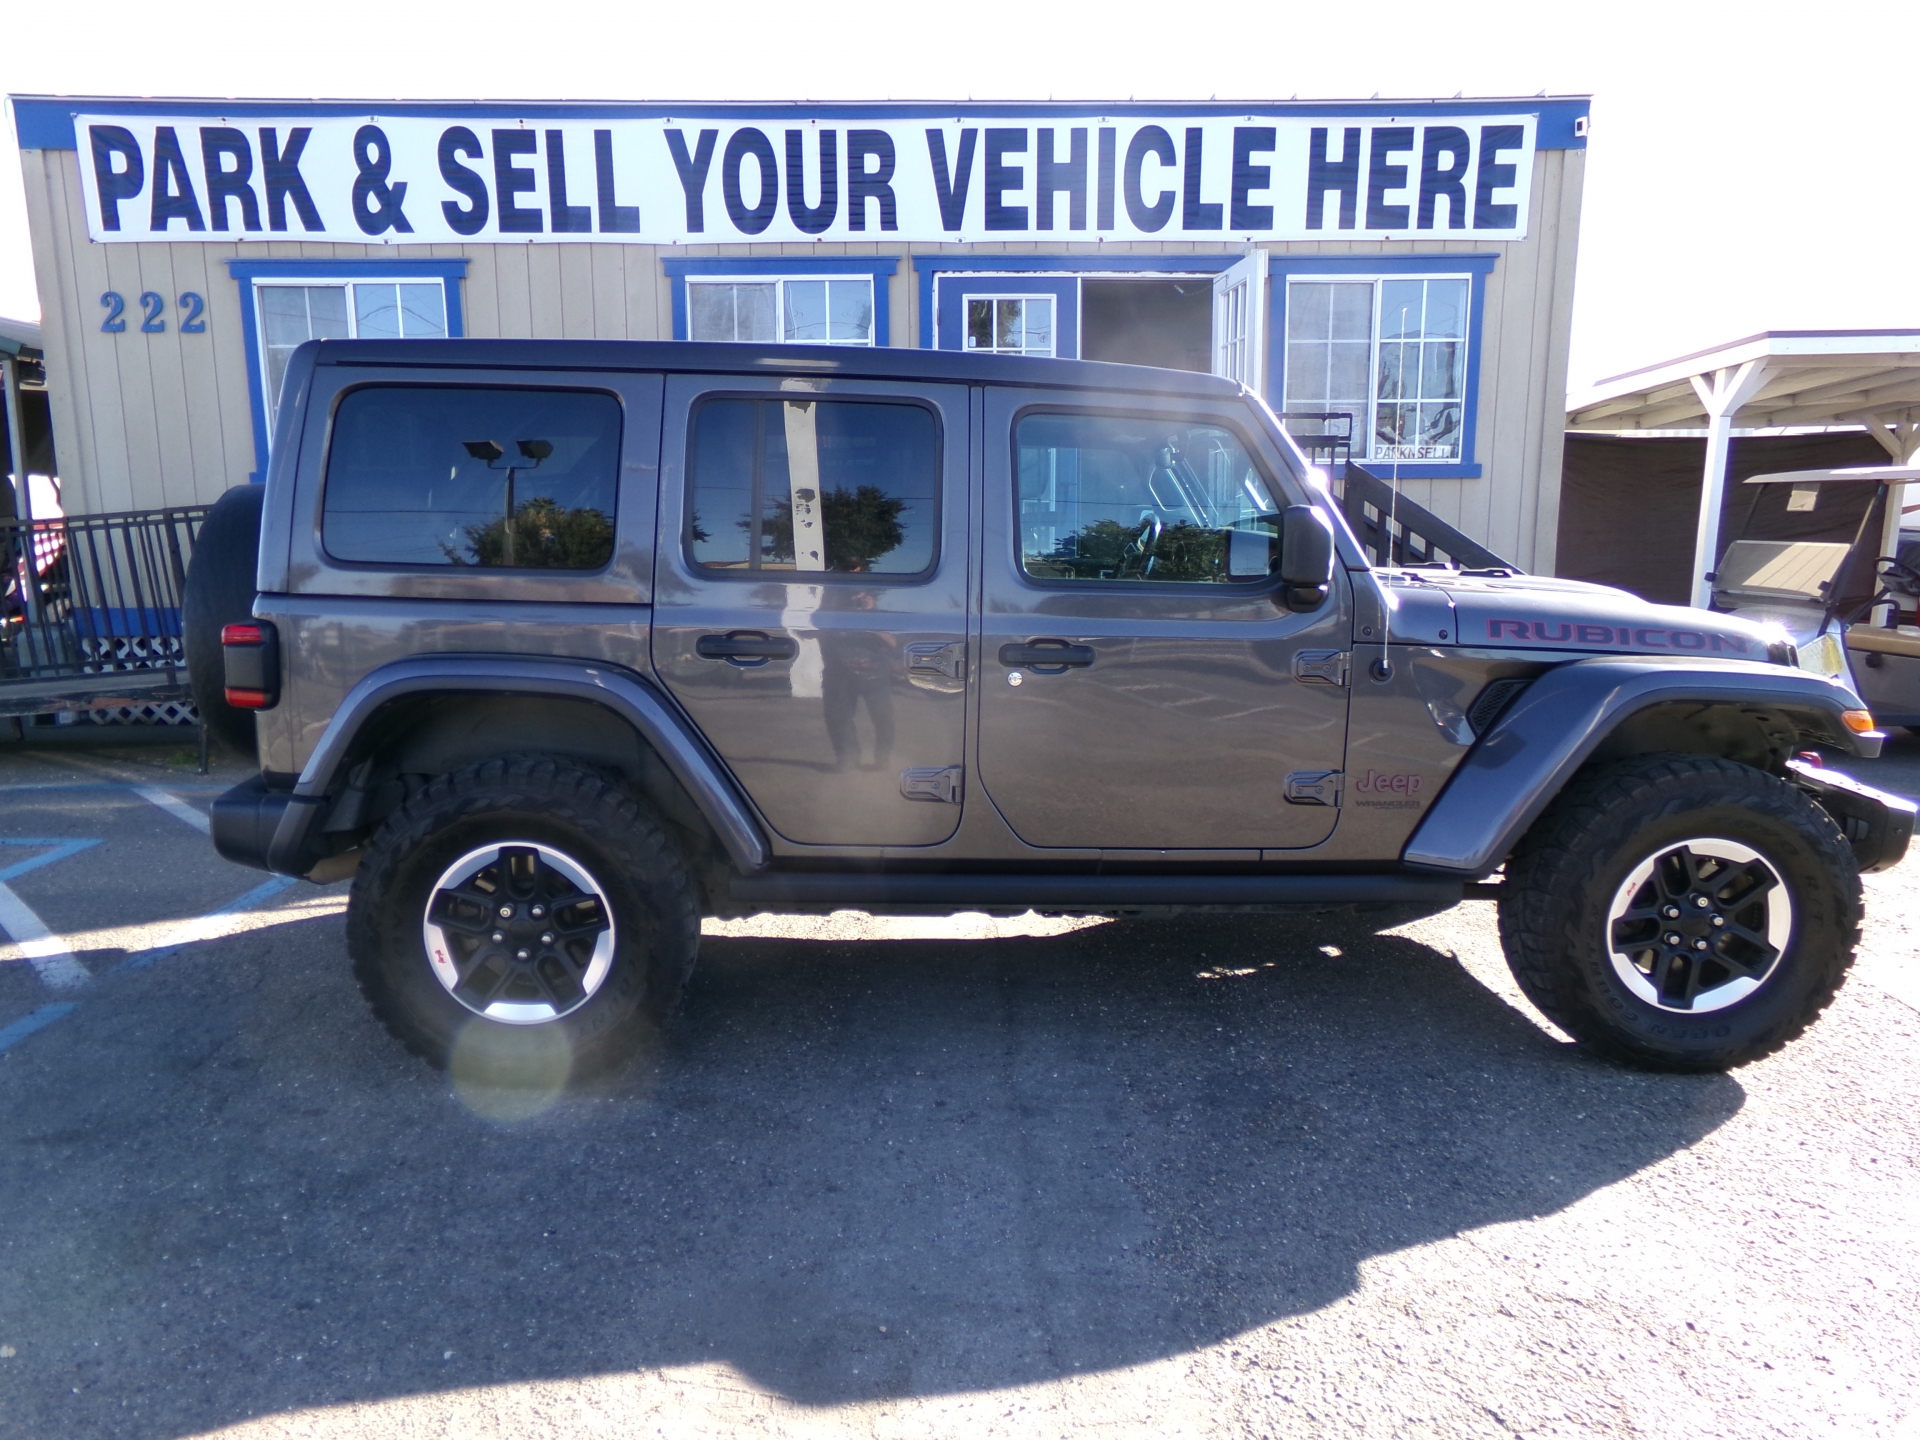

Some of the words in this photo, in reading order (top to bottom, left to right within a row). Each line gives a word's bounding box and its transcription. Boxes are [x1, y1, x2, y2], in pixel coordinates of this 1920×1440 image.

[88, 124, 326, 233] PARK
[351, 124, 415, 236] &
[437, 125, 641, 236] SELL
[664, 126, 899, 236] YOUR
[925, 124, 1277, 234] VEHICLE
[1305, 124, 1525, 231] HERE
[99, 291, 206, 334] 222
[1486, 618, 1748, 653] RUBICON
[1356, 769, 1423, 796] Jeep
